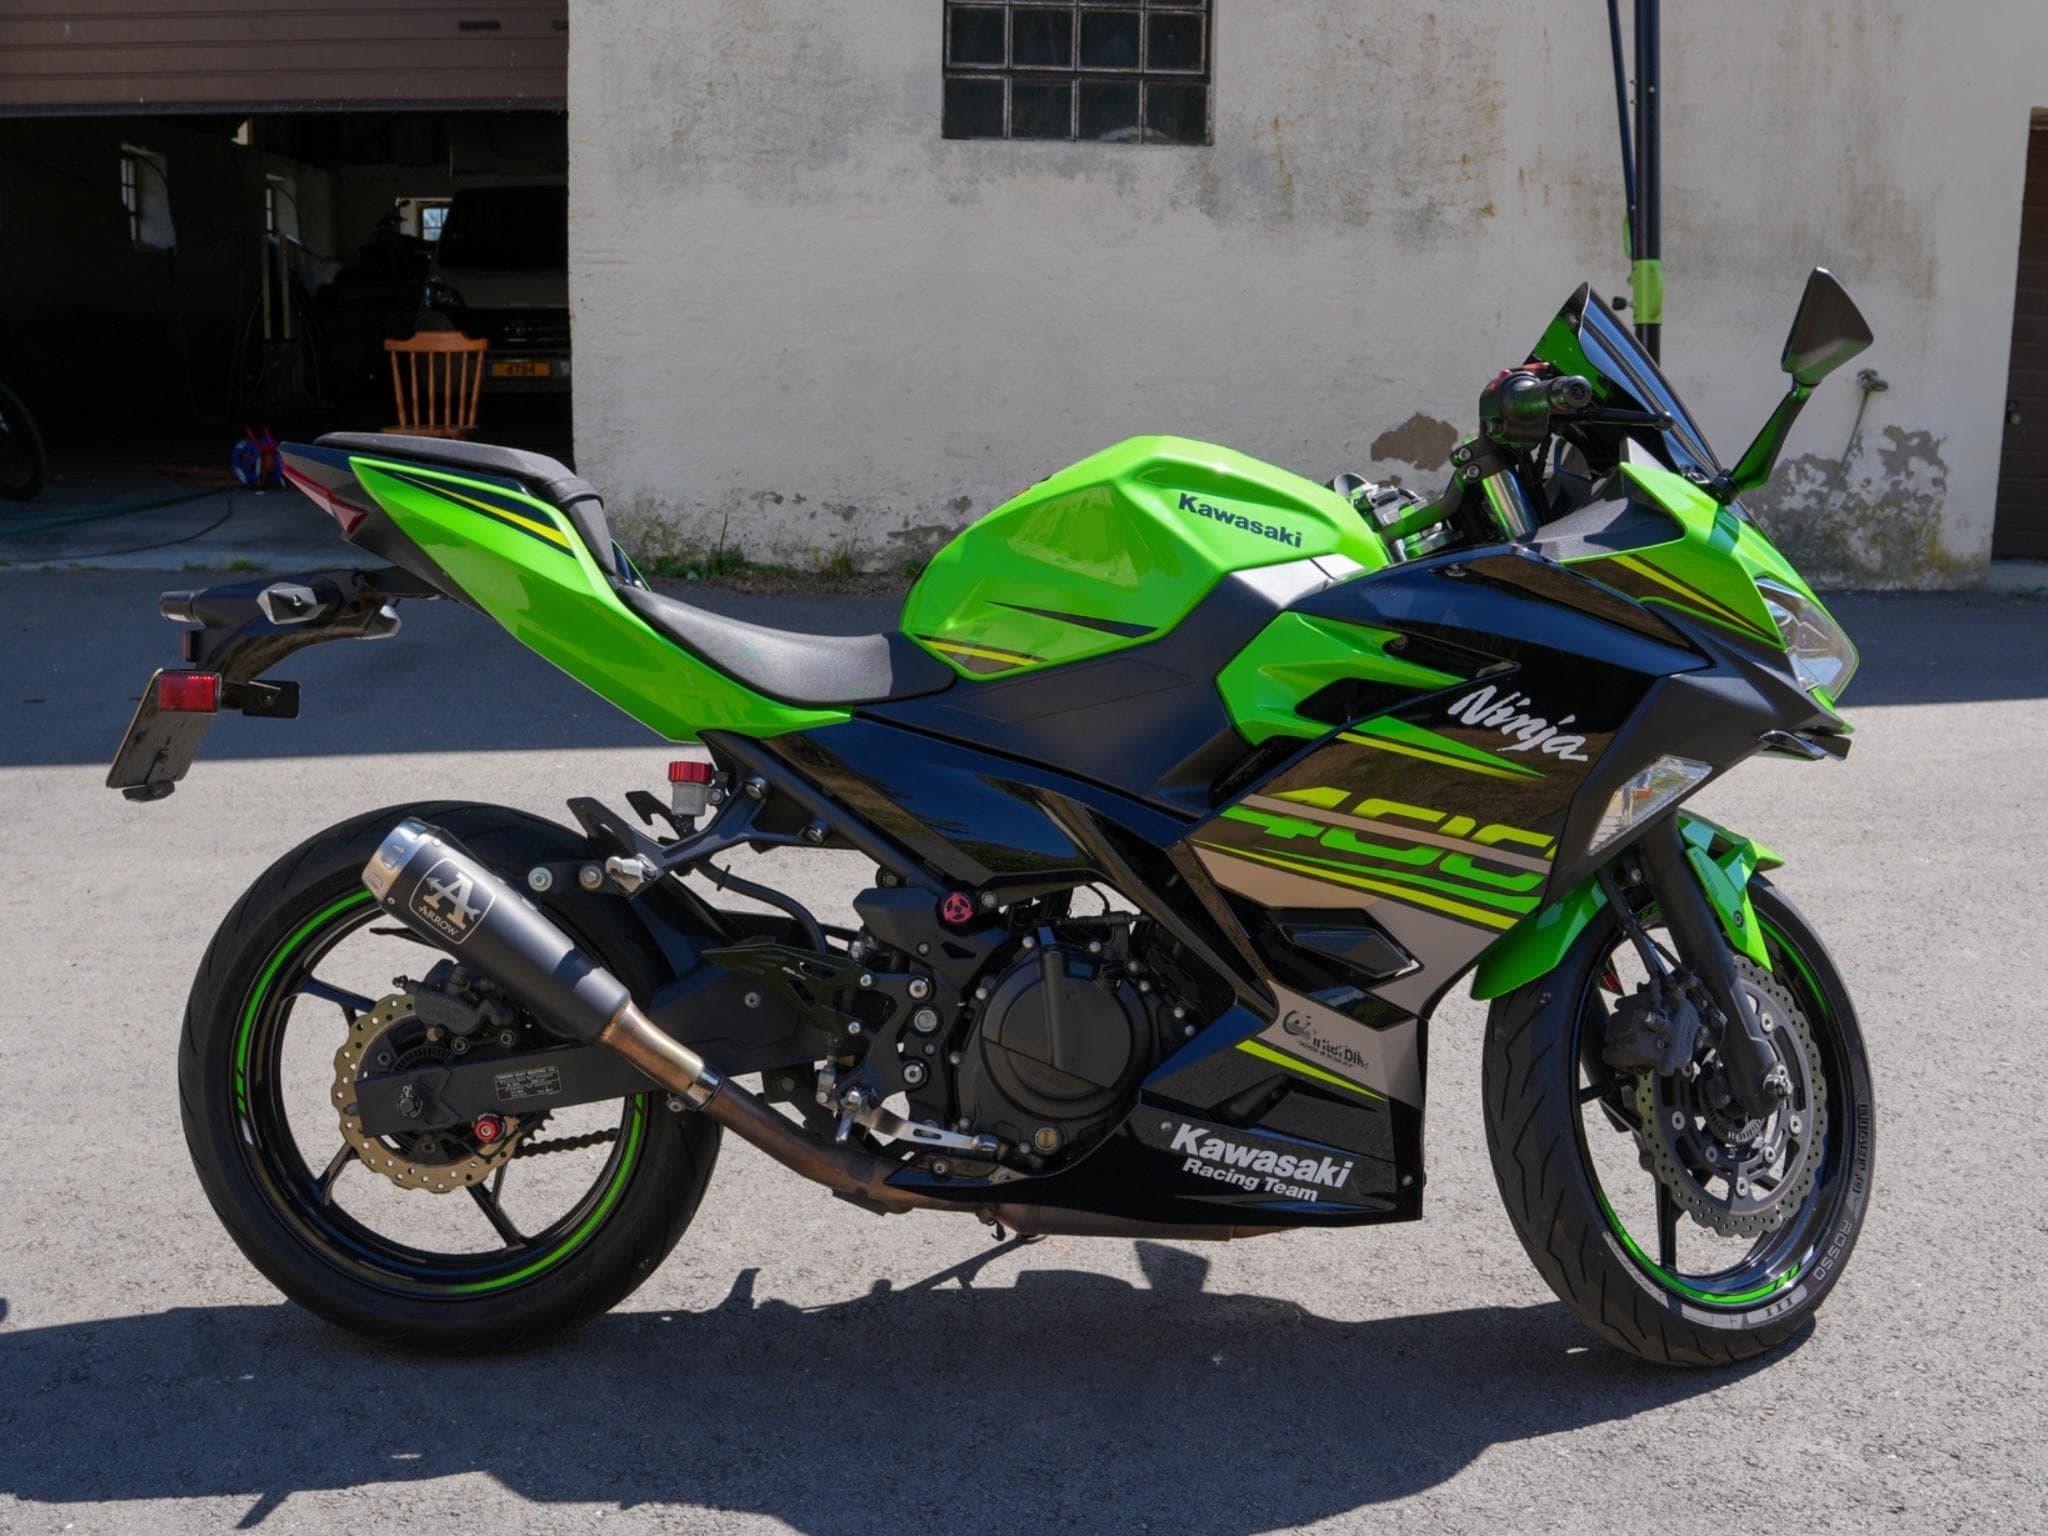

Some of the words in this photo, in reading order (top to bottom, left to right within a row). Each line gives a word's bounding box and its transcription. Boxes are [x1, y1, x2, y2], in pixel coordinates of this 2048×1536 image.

[1178, 492, 1302, 548] Kawasaki
[1448, 685, 1588, 762] Ninja
[1220, 786, 1557, 892] 400
[418, 905, 459, 937] ARROW
[1170, 1123, 1354, 1188] Kawasaki
[1182, 1158, 1260, 1191] Racing
[1264, 1177, 1318, 1202] Team
[1813, 1220, 1852, 1281] ROSSO
